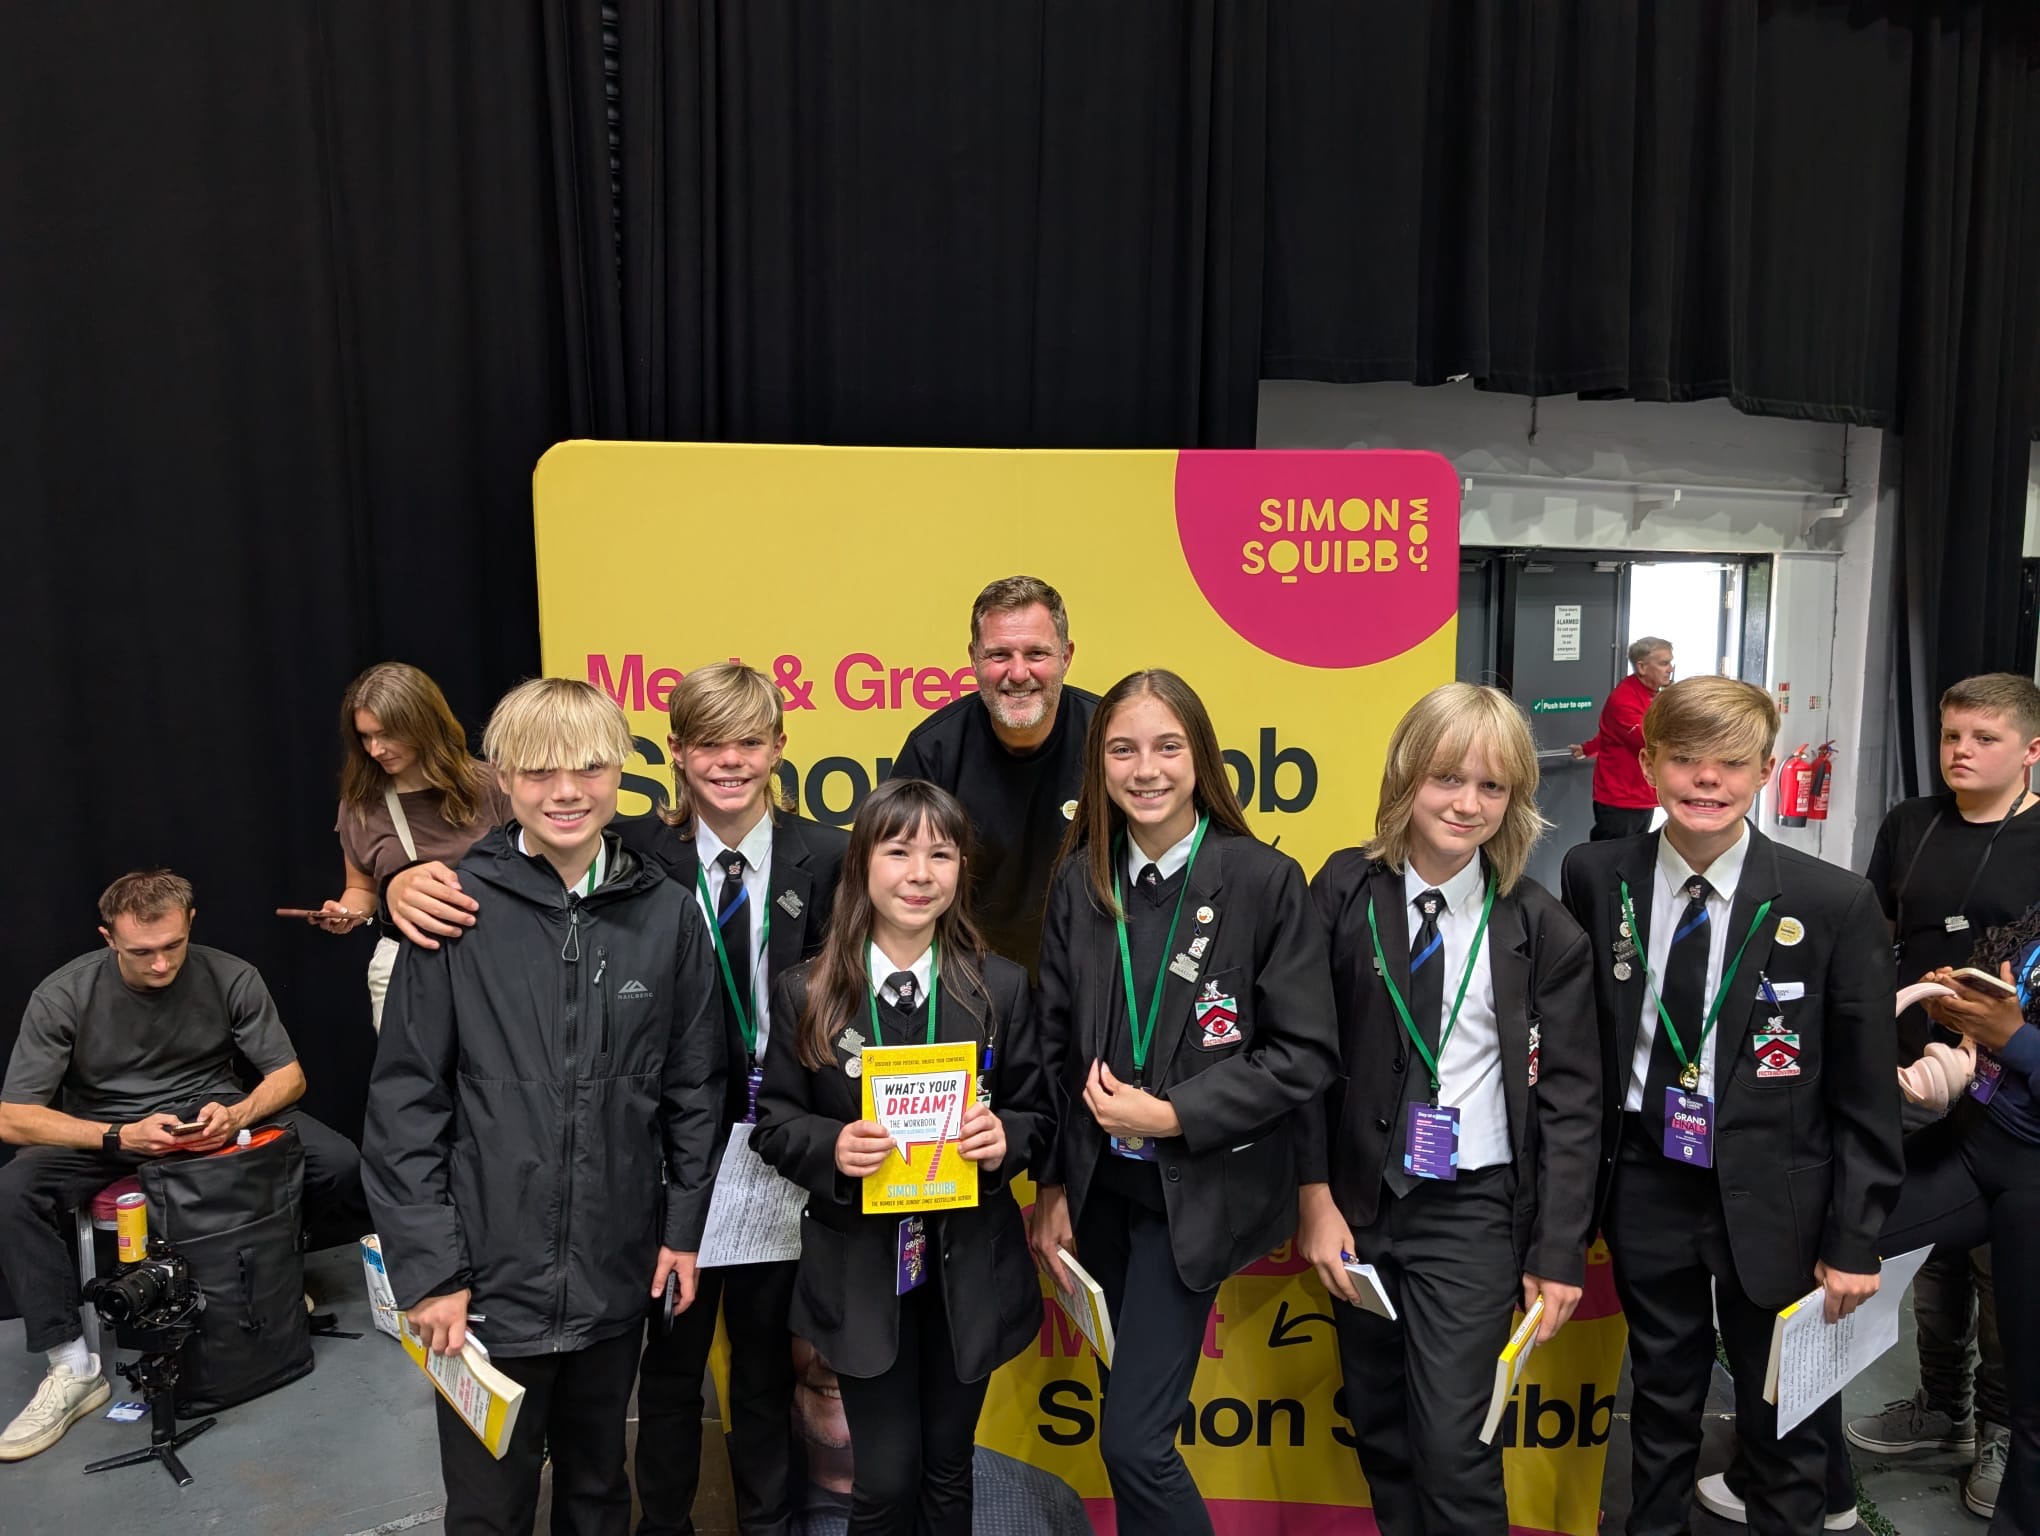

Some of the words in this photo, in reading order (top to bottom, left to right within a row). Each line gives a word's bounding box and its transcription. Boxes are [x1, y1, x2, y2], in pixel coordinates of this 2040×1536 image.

[1259, 498, 1399, 532] SIMON
[1241, 540, 1399, 583] SQUIBB
[772, 654, 816, 711] &
[834, 653, 979, 711] Gree
[1543, 702, 1558, 710] Push
[1577, 701, 1592, 709] open
[885, 1082, 925, 1095] WHAT'S
[929, 1080, 957, 1093] YOUR
[886, 1094, 957, 1115] DREAM?
[890, 1119, 900, 1129] THE
[904, 1118, 936, 1128] WORKBOOK
[1673, 1119, 1705, 1133] FINALS
[1674, 1112, 1706, 1126] GRAND
[888, 1184, 918, 1198] SIMON
[923, 1182, 957, 1196] SQUIBB
